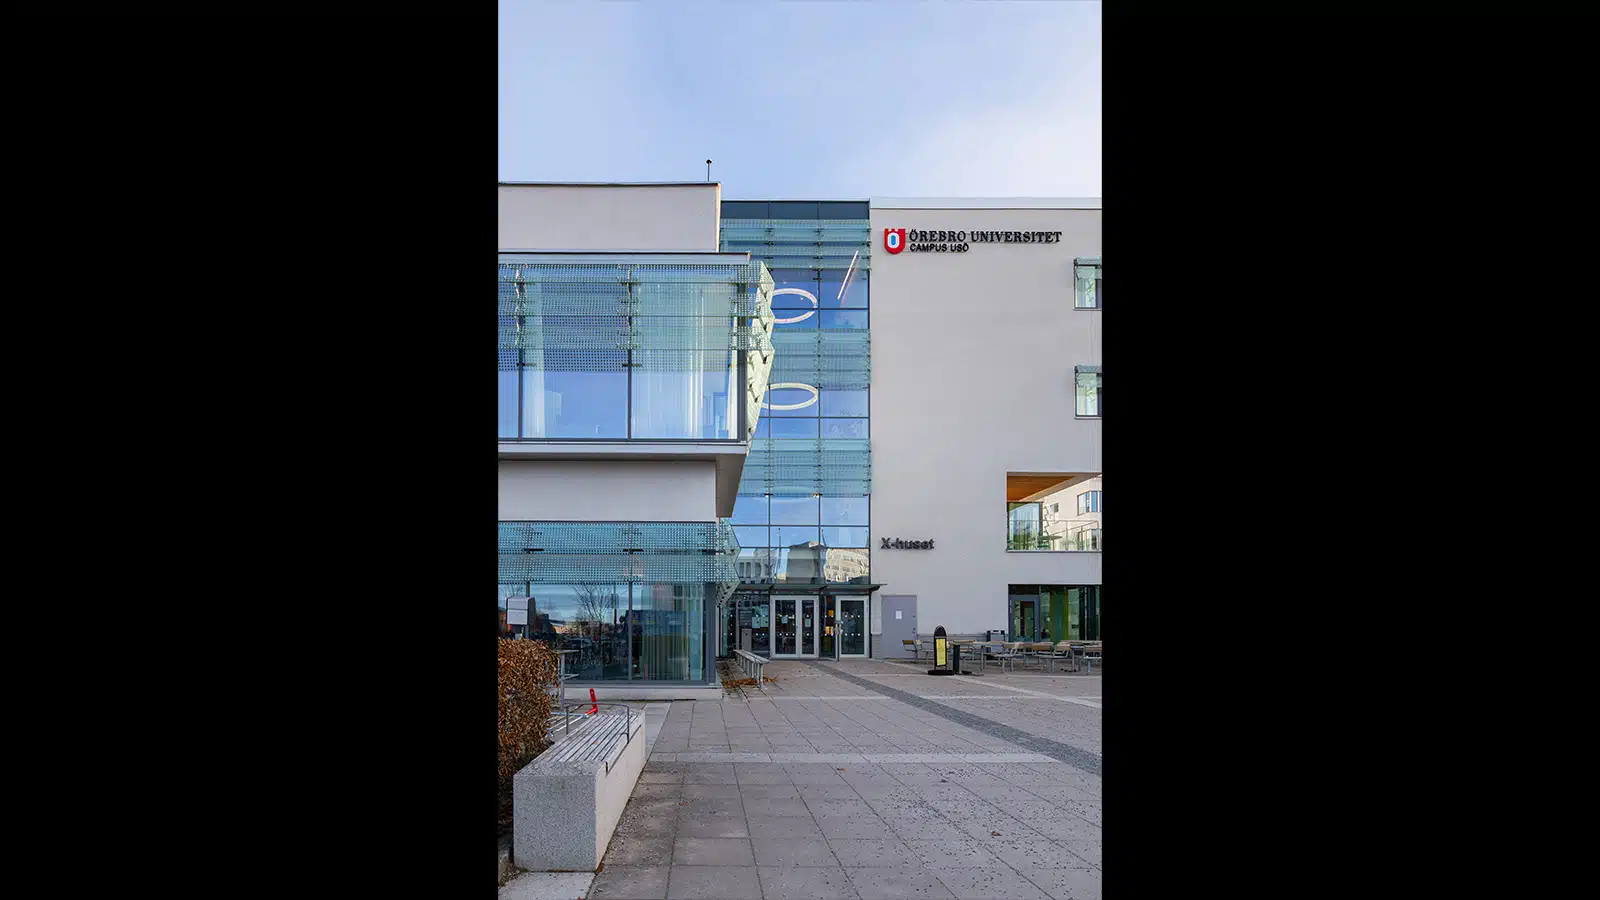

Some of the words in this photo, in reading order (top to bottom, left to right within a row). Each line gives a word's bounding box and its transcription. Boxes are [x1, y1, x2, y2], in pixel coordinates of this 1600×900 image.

[909, 229, 967, 243] ÖREBRO
[971, 231, 1062, 243] UNIVERSITET
[910, 243, 947, 252] CAMPUS
[951, 242, 970, 252] USÖ
[881, 537, 934, 549] X-huset
